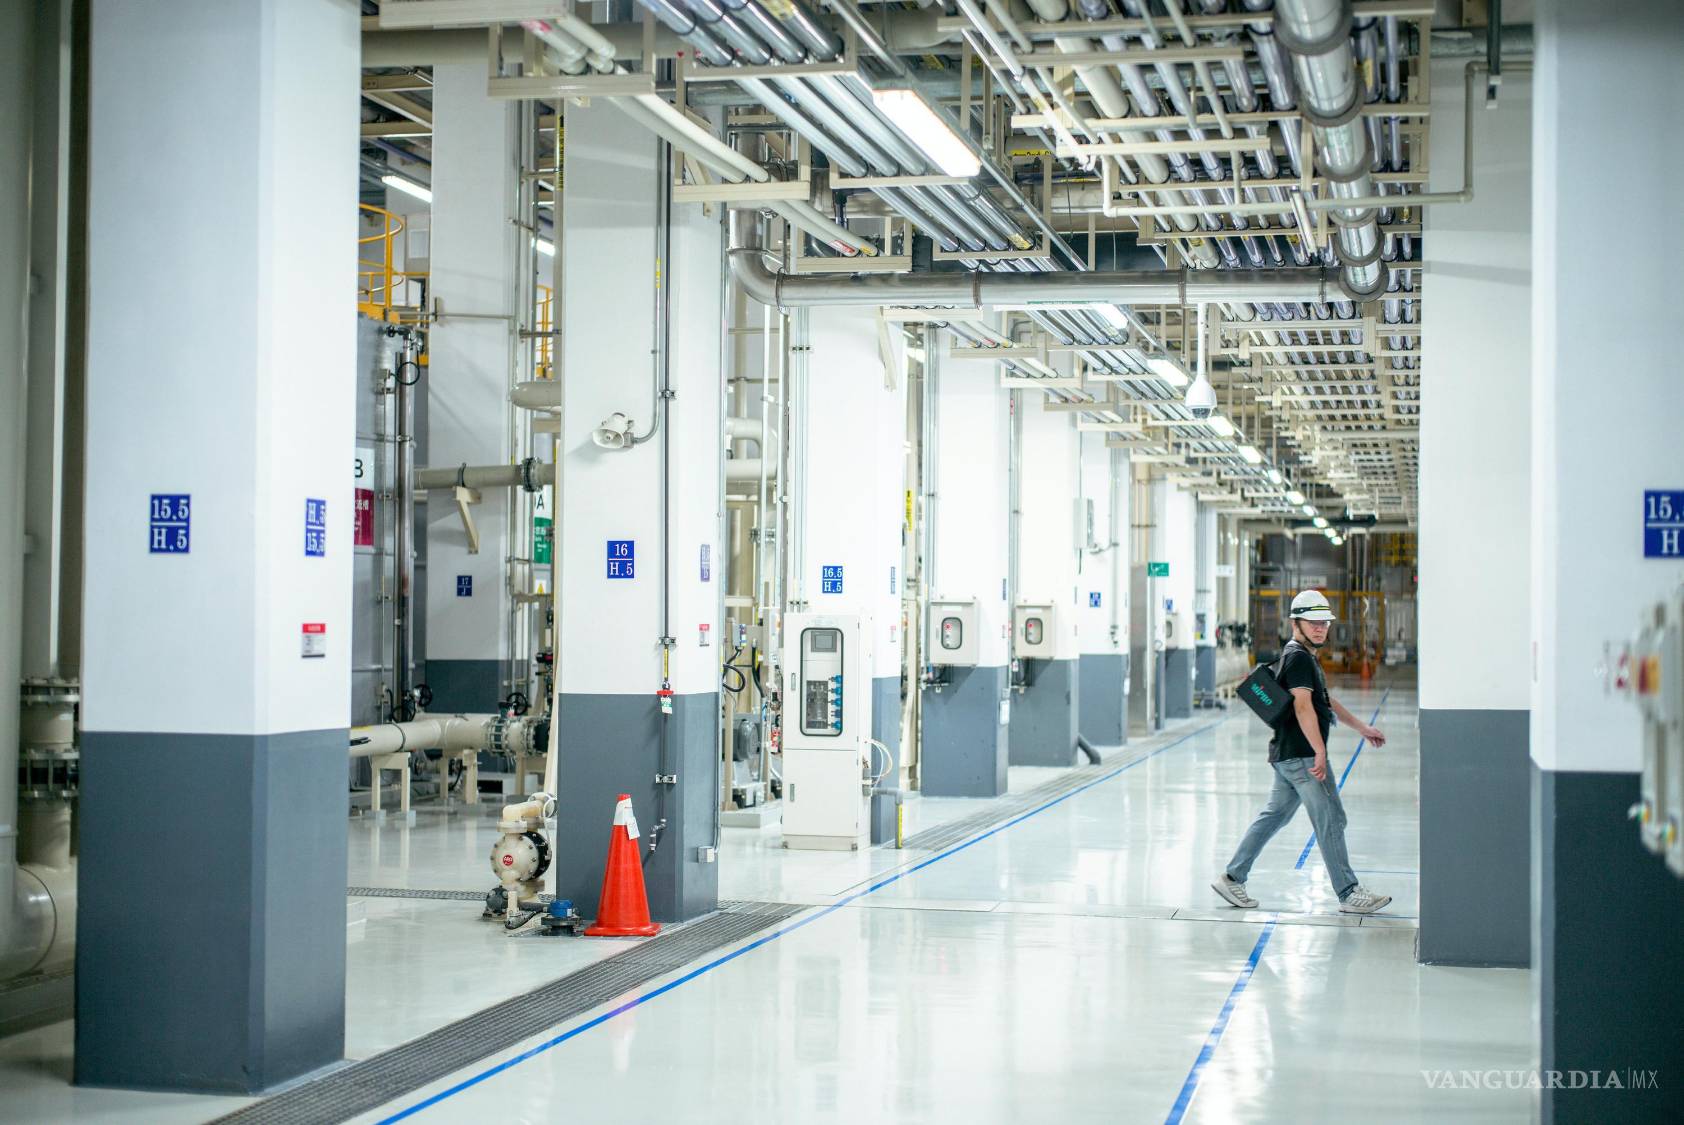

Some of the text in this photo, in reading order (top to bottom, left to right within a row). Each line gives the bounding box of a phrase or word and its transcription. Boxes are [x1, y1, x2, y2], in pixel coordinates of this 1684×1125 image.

[152, 499, 190, 520] 15.5
[1647, 495, 1684, 523] 15.
[152, 528, 188, 550] H.5
[614, 543, 628, 556] 16
[609, 561, 633, 577] H.5
[824, 567, 842, 578] 16.5
[824, 581, 842, 593] H.5
